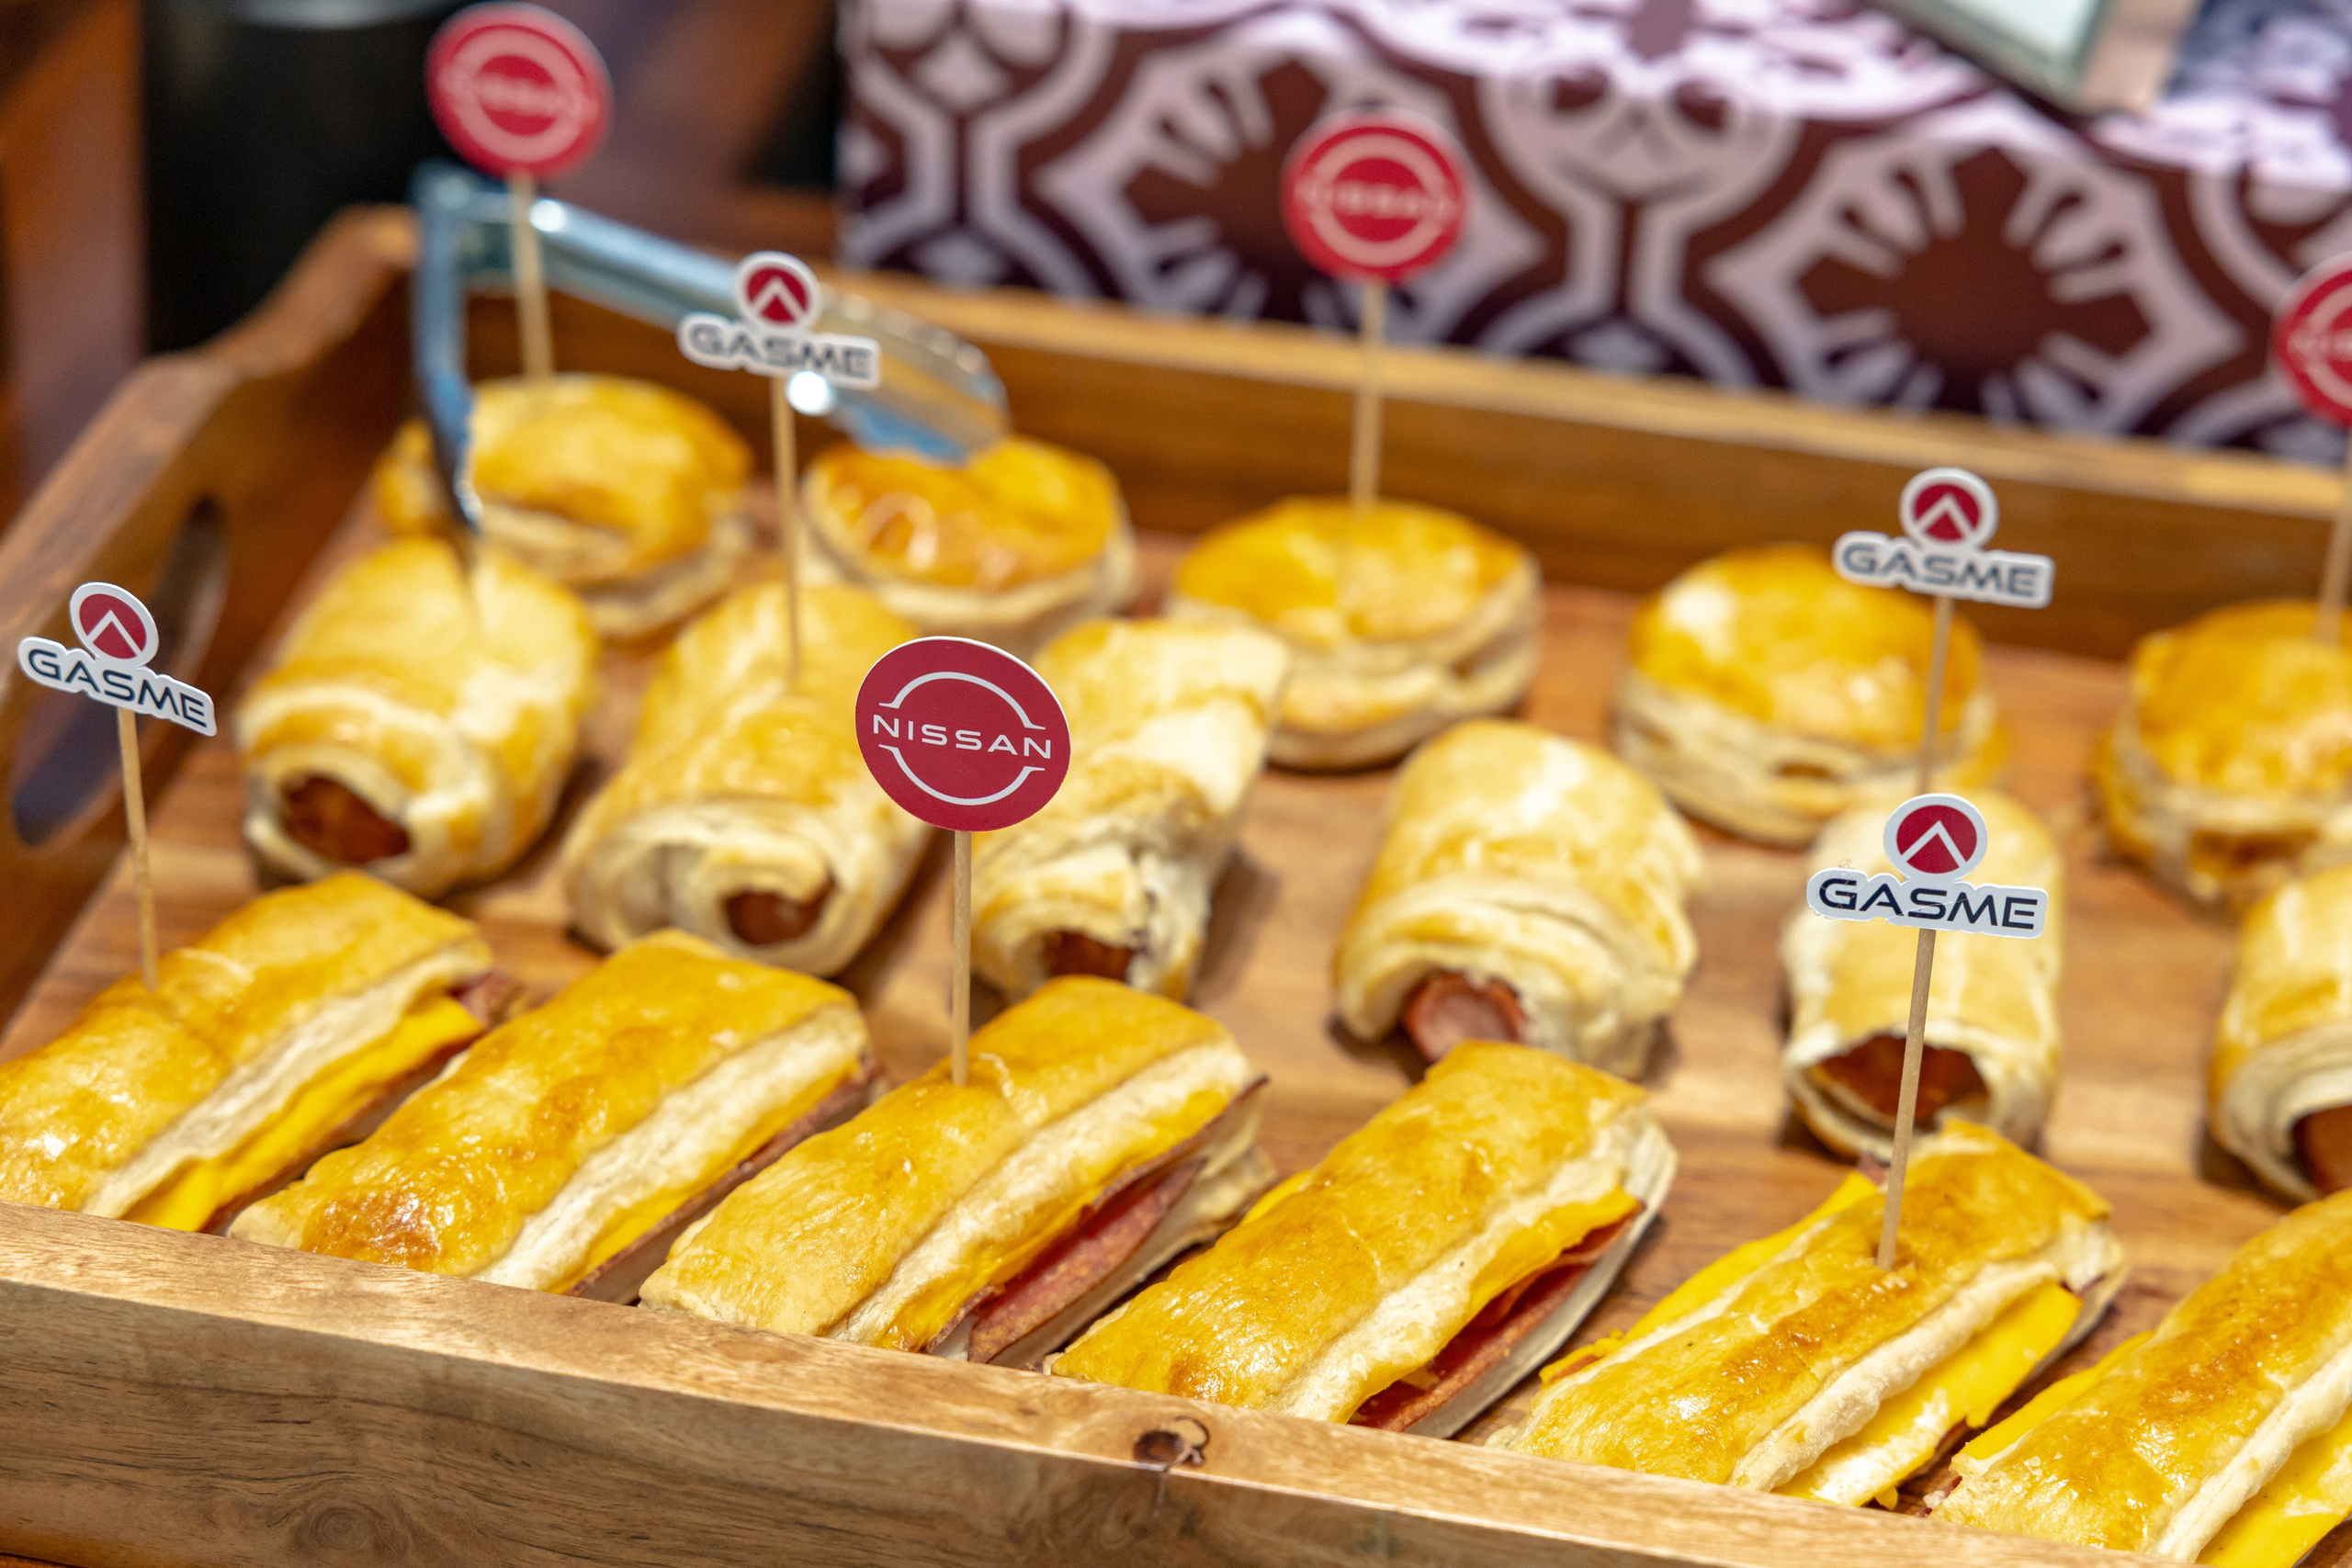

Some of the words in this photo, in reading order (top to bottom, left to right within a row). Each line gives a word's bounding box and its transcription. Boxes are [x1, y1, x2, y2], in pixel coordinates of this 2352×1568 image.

[689, 321, 873, 379] GASME
[1841, 541, 2038, 598] GASME
[28, 649, 207, 728] GASME
[873, 714, 1051, 759] NISSAN
[1819, 877, 2038, 929] GASME
